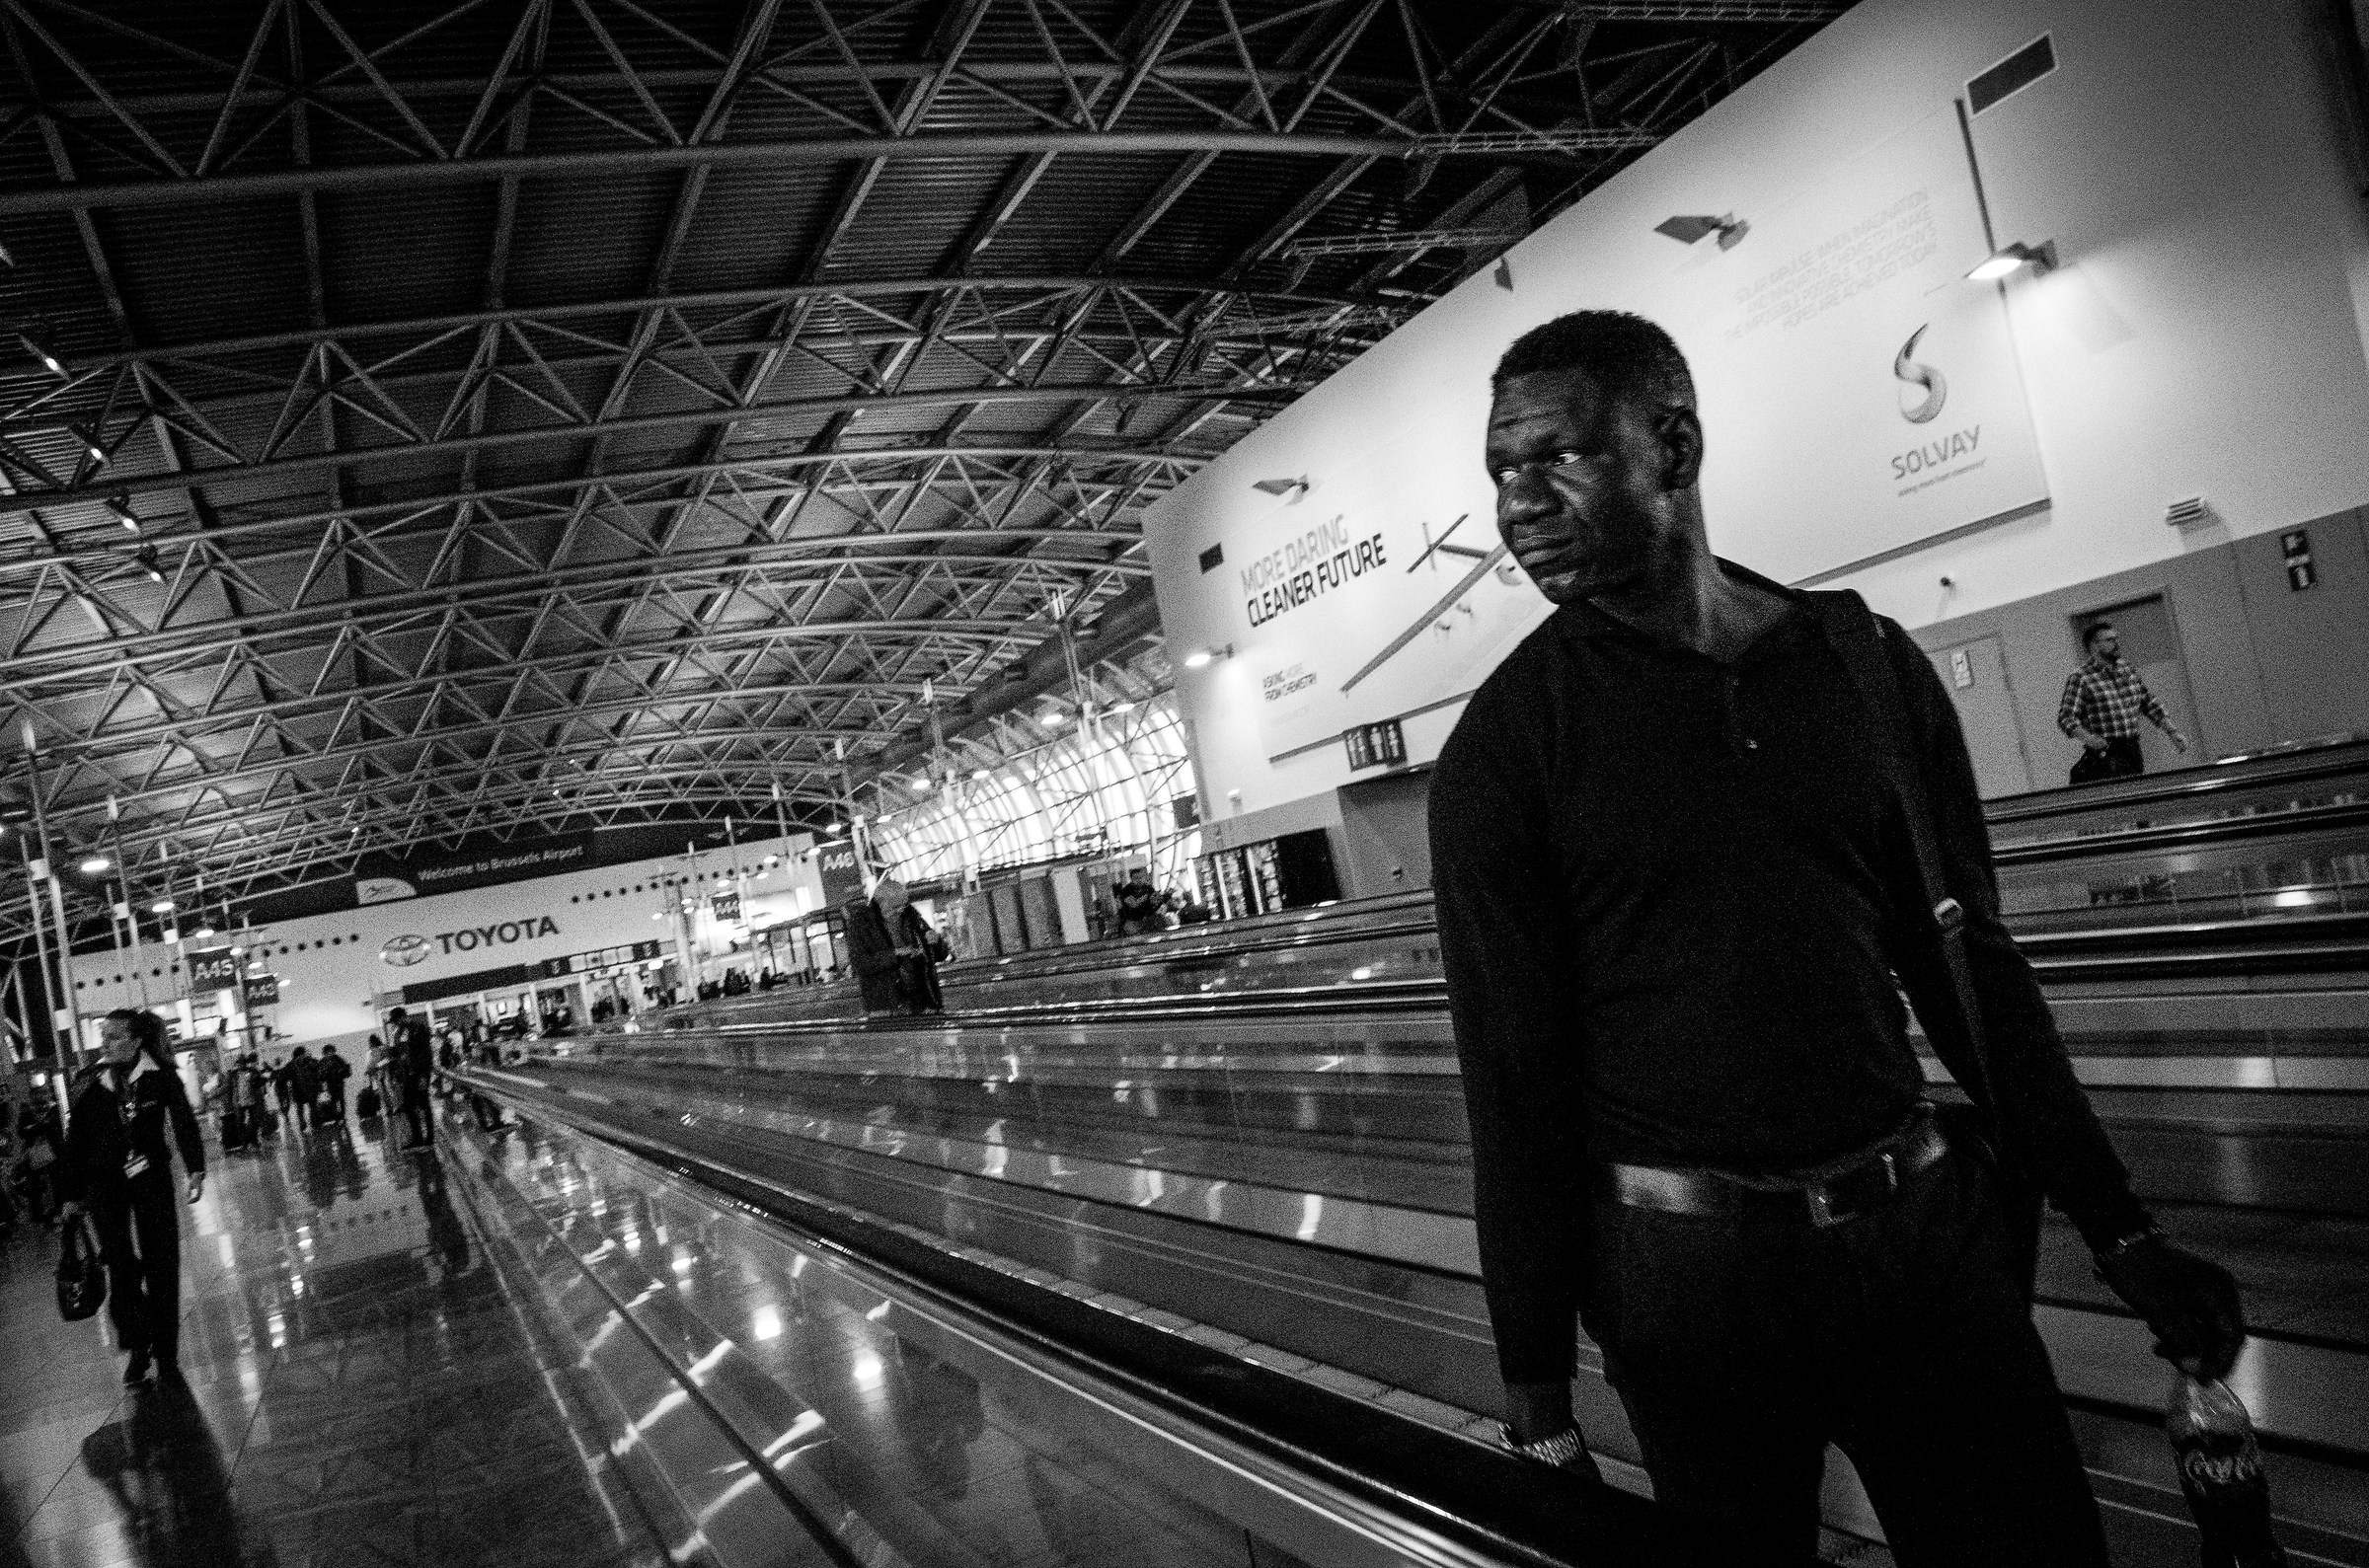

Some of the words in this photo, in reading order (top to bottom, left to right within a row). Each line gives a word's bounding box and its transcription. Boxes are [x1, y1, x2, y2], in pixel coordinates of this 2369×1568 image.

[1891, 425, 1979, 480] SOLVAY
[1241, 549, 1284, 596] MORE
[1286, 513, 1347, 573] DARING
[1248, 570, 1317, 628] CLEANER
[1317, 533, 1387, 593] FUTURE
[418, 864, 474, 881] Welcome
[476, 861, 490, 871] to
[491, 852, 541, 869] Brussels
[543, 845, 584, 860] Airport
[435, 916, 561, 954] TOYOTA
[195, 958, 234, 981] A45
